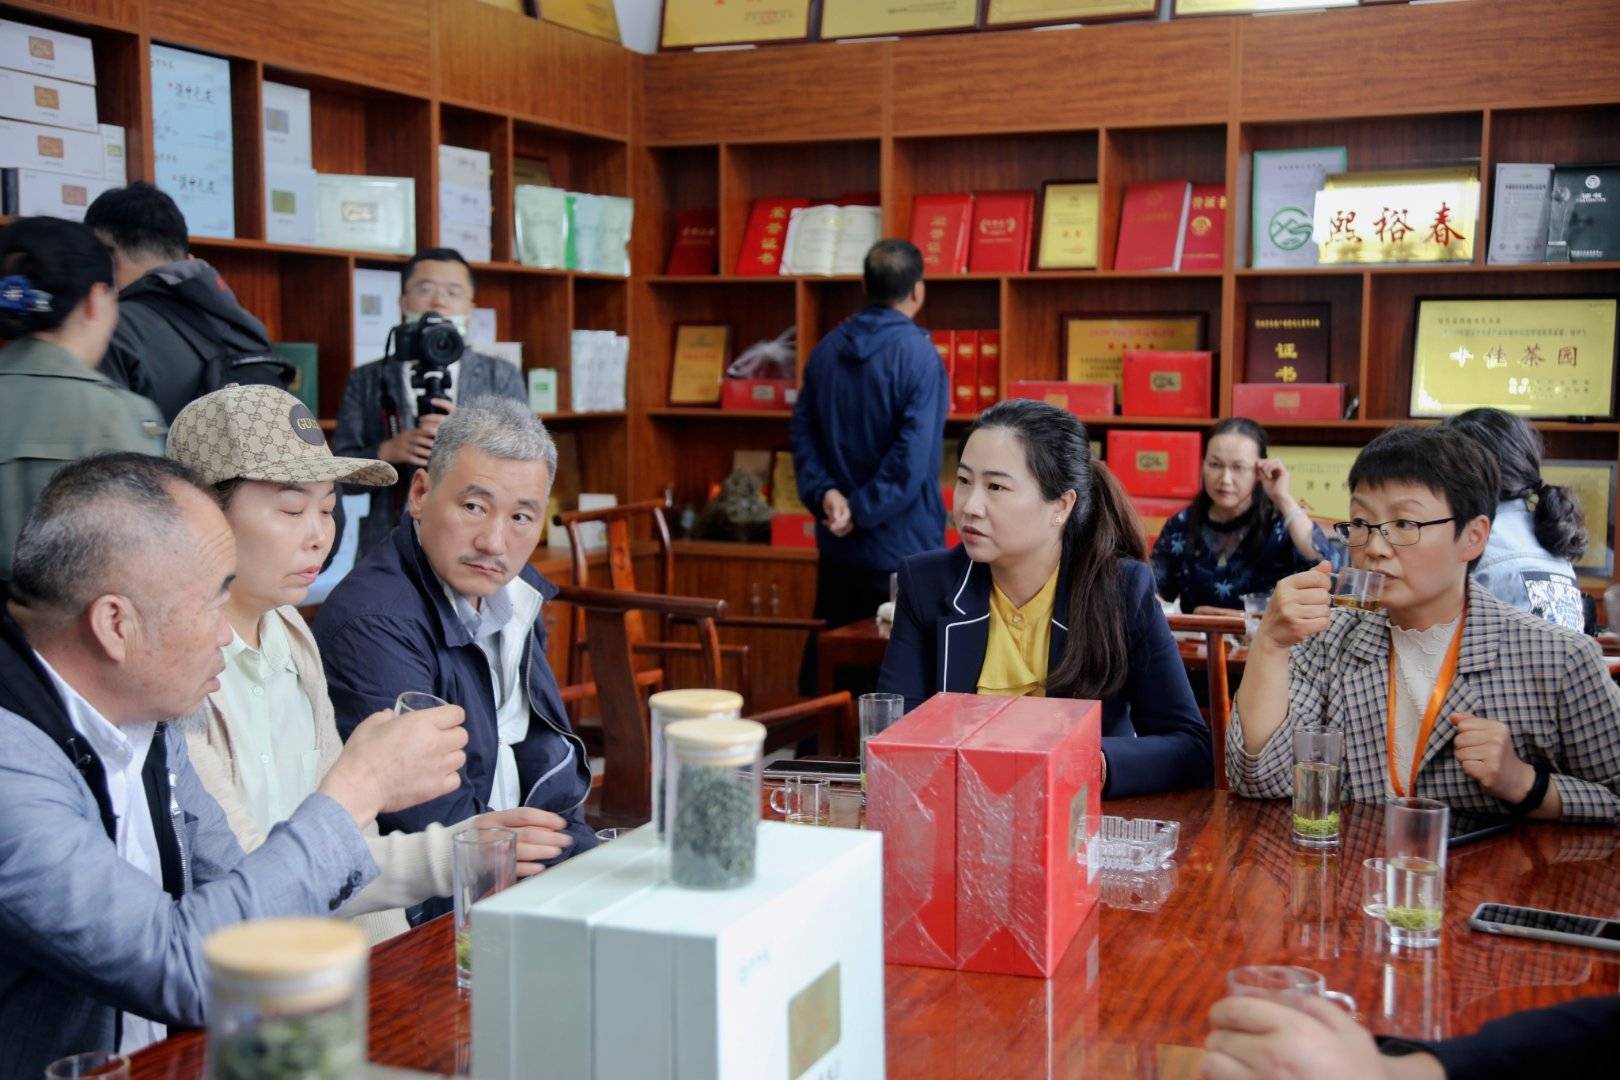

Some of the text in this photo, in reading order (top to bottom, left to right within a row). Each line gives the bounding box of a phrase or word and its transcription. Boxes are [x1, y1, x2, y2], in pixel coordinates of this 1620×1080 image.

[1325, 202, 1466, 248] 熙裕春
[1449, 343, 1578, 368] 十佳茶园
